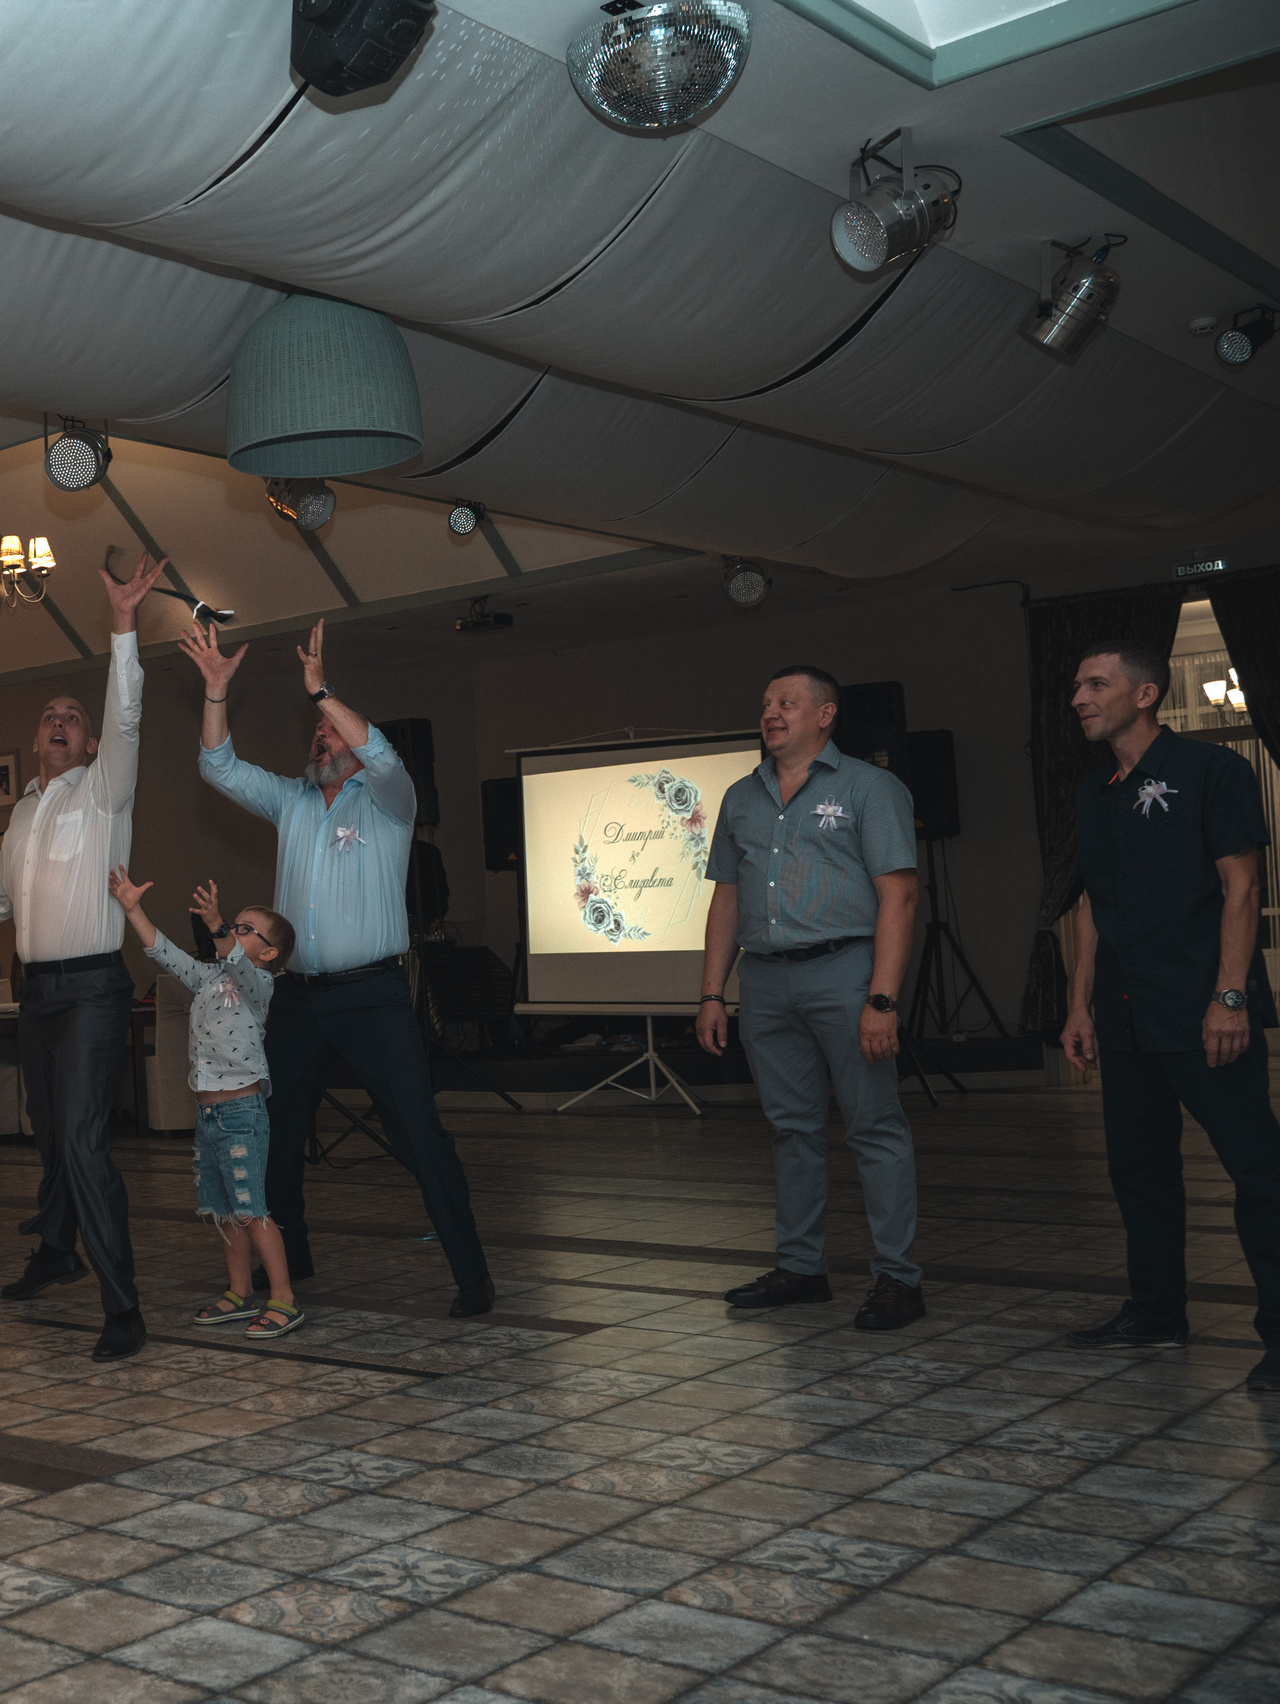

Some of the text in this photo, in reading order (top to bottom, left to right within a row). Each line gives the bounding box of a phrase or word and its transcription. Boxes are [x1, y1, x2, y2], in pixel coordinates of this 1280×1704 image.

[1177, 560, 1223, 576] ВЫХОД
[603, 821, 668, 851] Дмитрий
[600, 866, 674, 902] Елизавета
